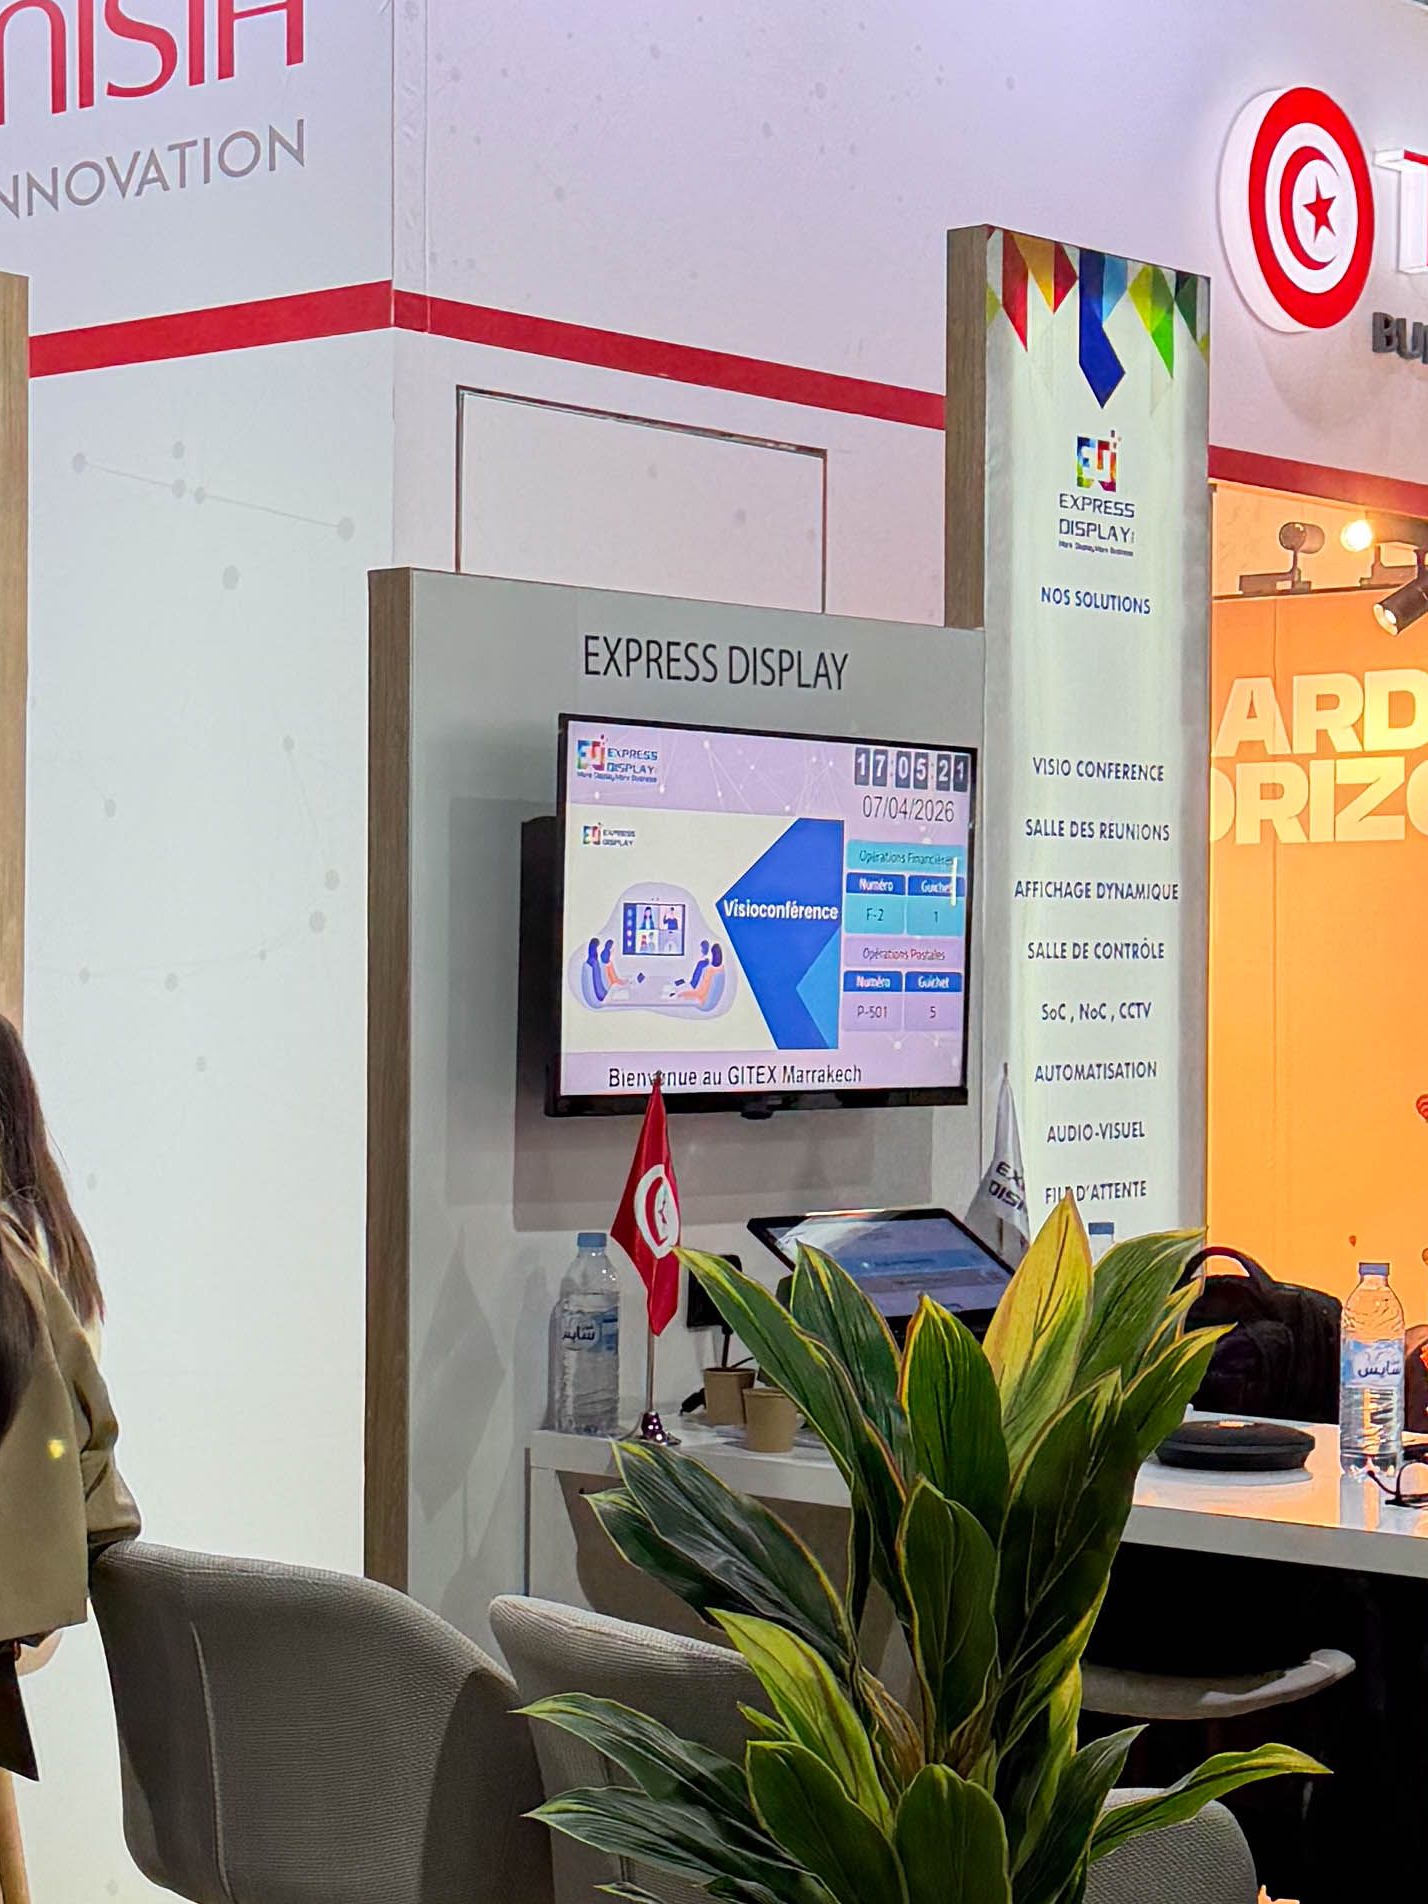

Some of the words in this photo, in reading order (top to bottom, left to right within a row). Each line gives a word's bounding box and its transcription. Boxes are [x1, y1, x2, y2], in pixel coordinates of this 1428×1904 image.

[1059, 492, 1135, 518] EXPRESS
[1059, 518, 1131, 543] DISPLAY
[1041, 586, 1071, 606] NOS
[1075, 591, 1151, 615] SOLUTIONS
[583, 634, 718, 684] EXPRESS
[727, 645, 849, 691] DISPLAY
[607, 747, 659, 761] EXPRESS
[606, 761, 655, 775] DISPLAY
[1033, 756, 1072, 777] VISIO
[1076, 760, 1165, 782] CONFERENCE
[862, 795, 955, 822] 07/04/2026
[1025, 818, 1065, 837] SALLE
[1071, 820, 1095, 839] DES
[1099, 816, 1171, 841] RÉUNIONS
[1014, 880, 1092, 900] AFFICHAGE
[1096, 882, 1179, 902] DYNAMIQUE
[723, 898, 839, 922] Visioconférence
[1027, 942, 1067, 960] SALLE
[1072, 942, 1090, 960] DE
[1094, 937, 1165, 960] CONTRÔLE
[1041, 1003, 1066, 1021] SoC
[1079, 1003, 1107, 1021] NoC
[1119, 1001, 1152, 1019] CCTV
[702, 1070, 722, 1086] au
[728, 1065, 776, 1086] GITEX
[781, 1063, 862, 1085] Marrakech
[1034, 1061, 1157, 1082] AUTOMATISATION
[1047, 1120, 1145, 1143] AUDIO-VISUEL
[996, 1161, 1025, 1191] EX
[1076, 1180, 1147, 1202] D'ATTENTE
